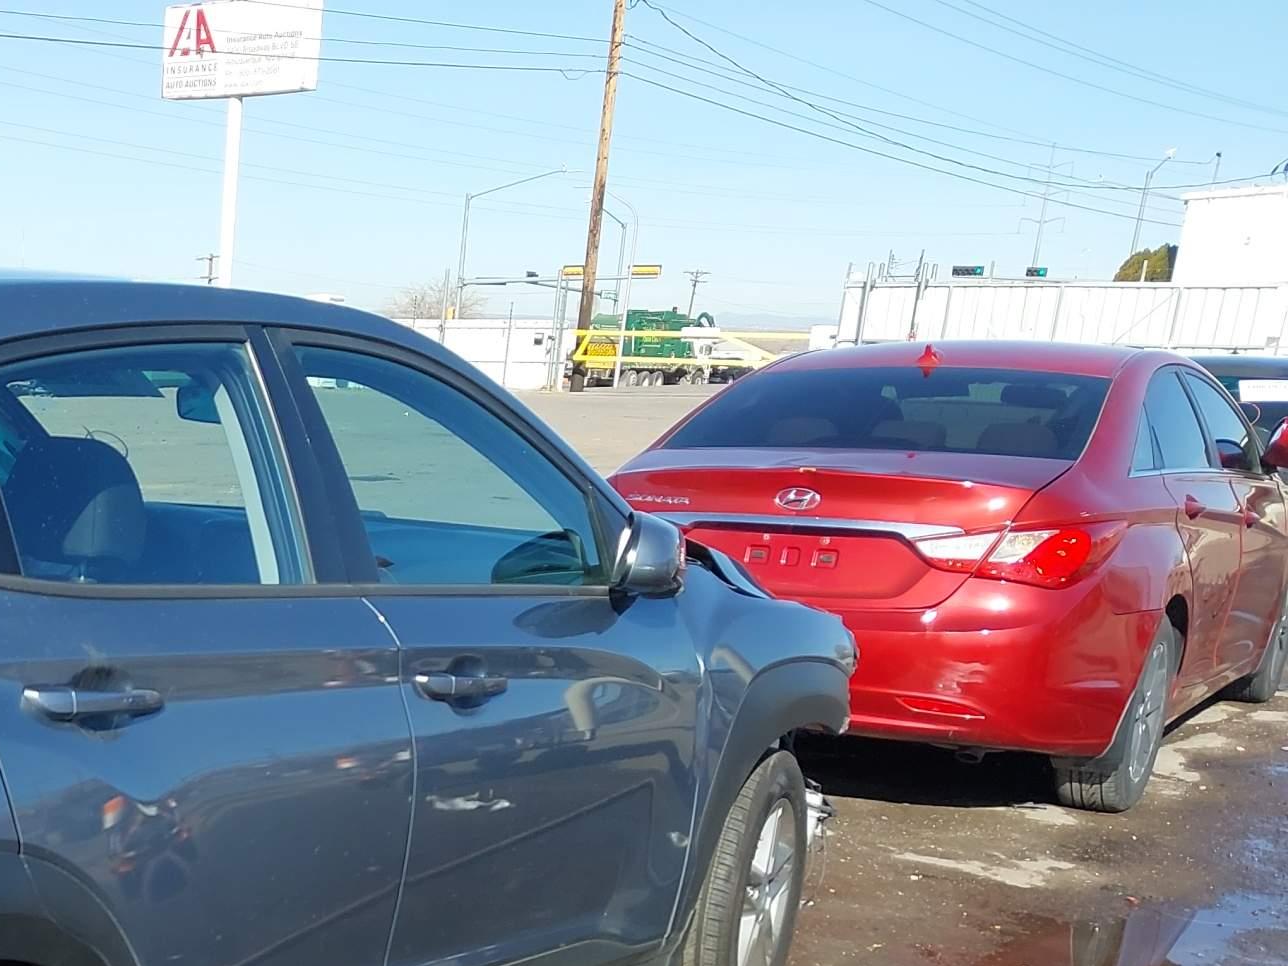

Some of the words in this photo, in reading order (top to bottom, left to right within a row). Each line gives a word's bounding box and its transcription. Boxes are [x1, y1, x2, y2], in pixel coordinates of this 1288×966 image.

[166, 63, 218, 75] INSURANCE
[165, 80, 184, 89] AUTO
[184, 78, 217, 88] AUCTIONS
